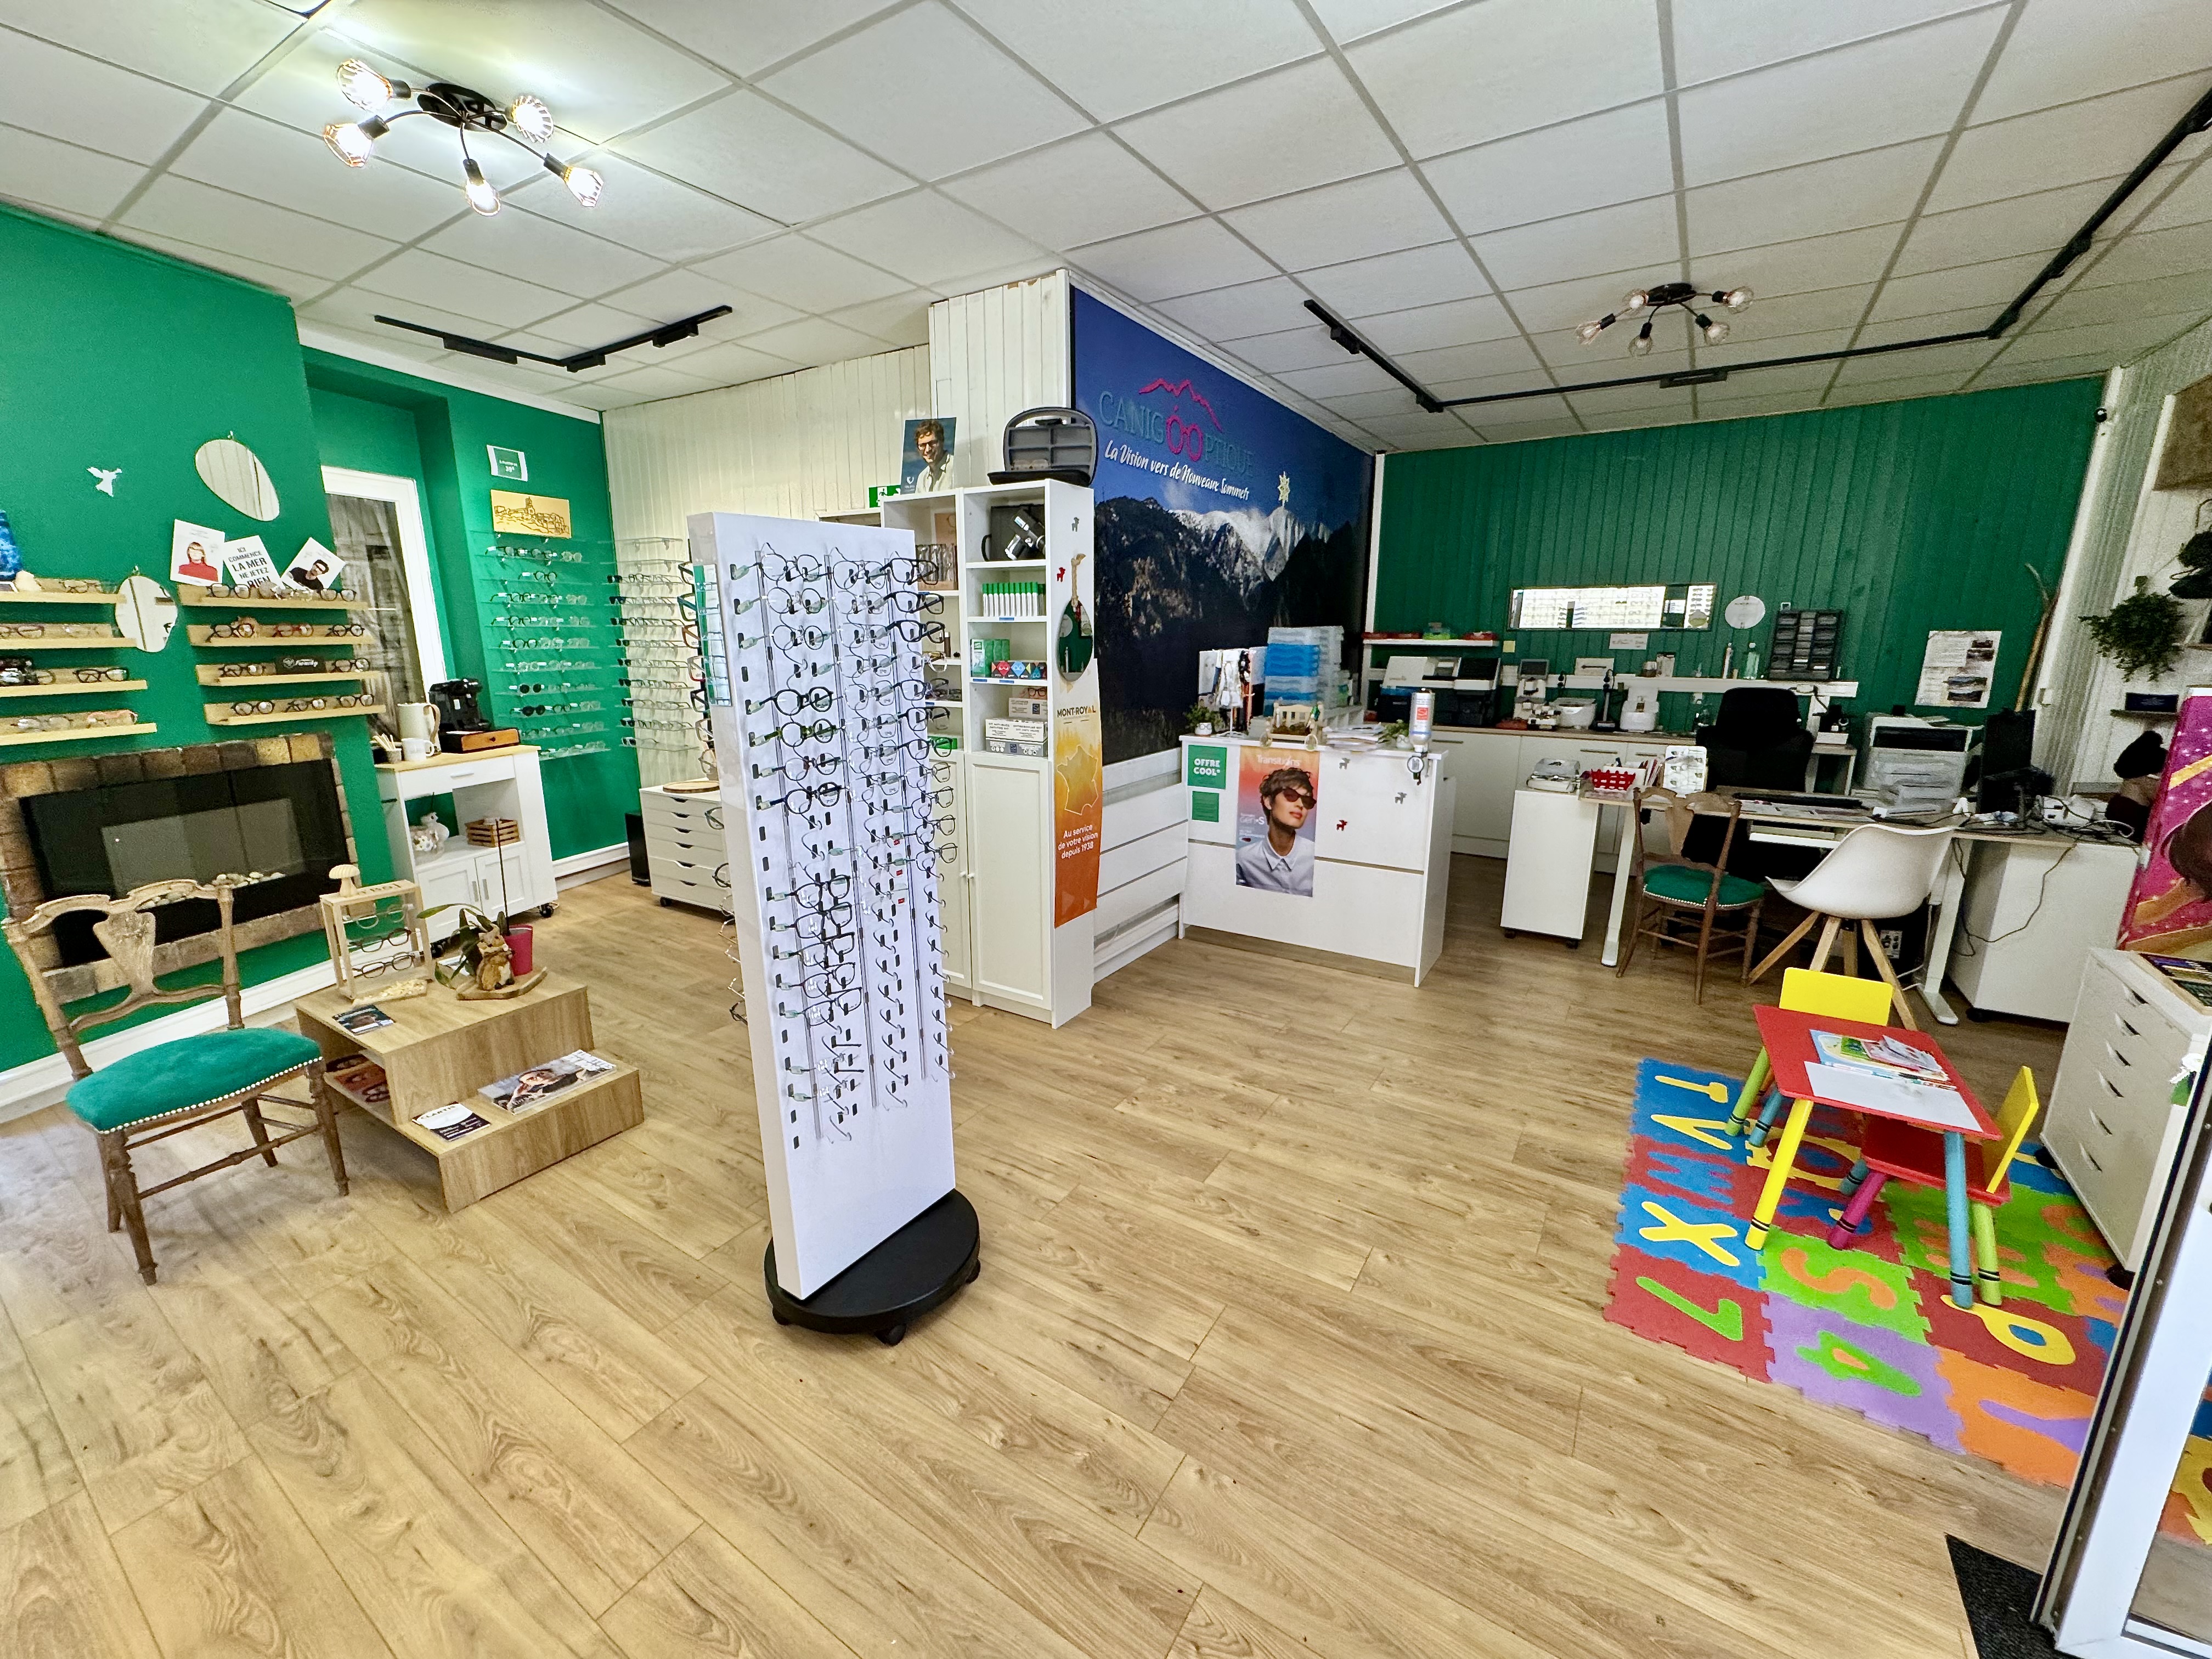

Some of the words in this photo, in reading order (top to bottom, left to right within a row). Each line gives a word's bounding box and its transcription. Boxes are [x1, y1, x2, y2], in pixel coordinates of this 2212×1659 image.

[1104, 440, 1118, 461] La
[1120, 444, 1149, 470] Vision
[1150, 460, 1169, 476] vers
[1169, 462, 1181, 479] de
[1180, 464, 1220, 492] Nouveaux
[1220, 478, 1250, 500] Sommets
[228, 550, 263, 563] COMMENCE
[232, 563, 246, 572] LA
[248, 557, 268, 569] MER
[250, 567, 269, 577] JETEZ
[1057, 705, 1096, 718] MONT-ROYAL
[1194, 758, 1220, 768] OFFRE
[1063, 830, 1072, 839] Au
[1073, 824, 1093, 836] service
[1058, 842, 1065, 851] de
[1066, 838, 1081, 848] votre
[1082, 832, 1098, 842] vision
[1061, 846, 1080, 859] depuis
